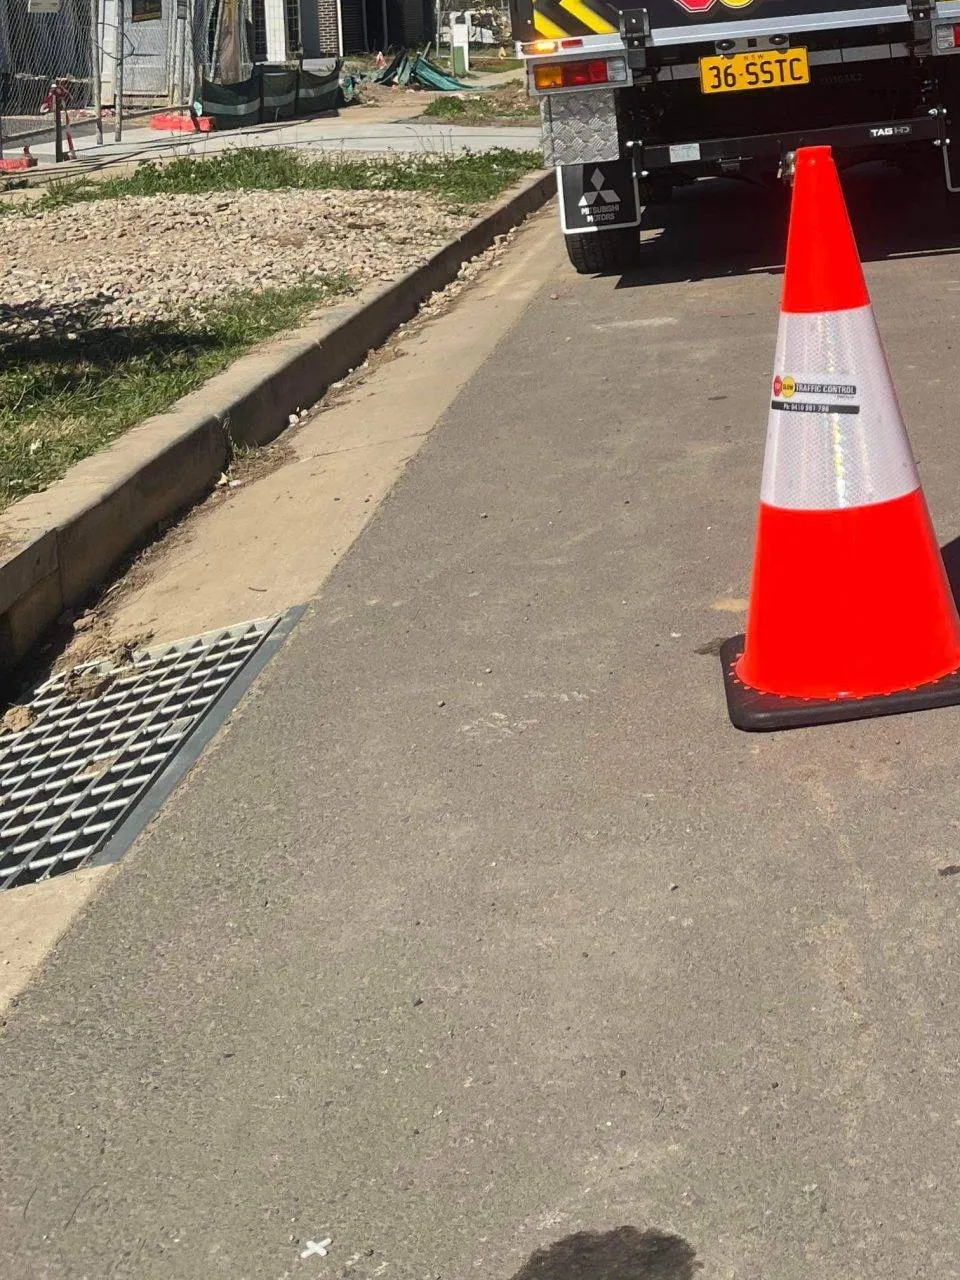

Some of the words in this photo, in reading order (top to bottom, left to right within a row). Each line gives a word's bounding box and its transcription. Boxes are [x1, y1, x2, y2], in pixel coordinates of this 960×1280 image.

[870, 127, 893, 137] TAG
[581, 204, 620, 215] MITSUBISHI
[586, 213, 615, 223] MOTORS
[796, 383, 822, 393] TRAFFIC
[823, 384, 855, 394] CONTROL
